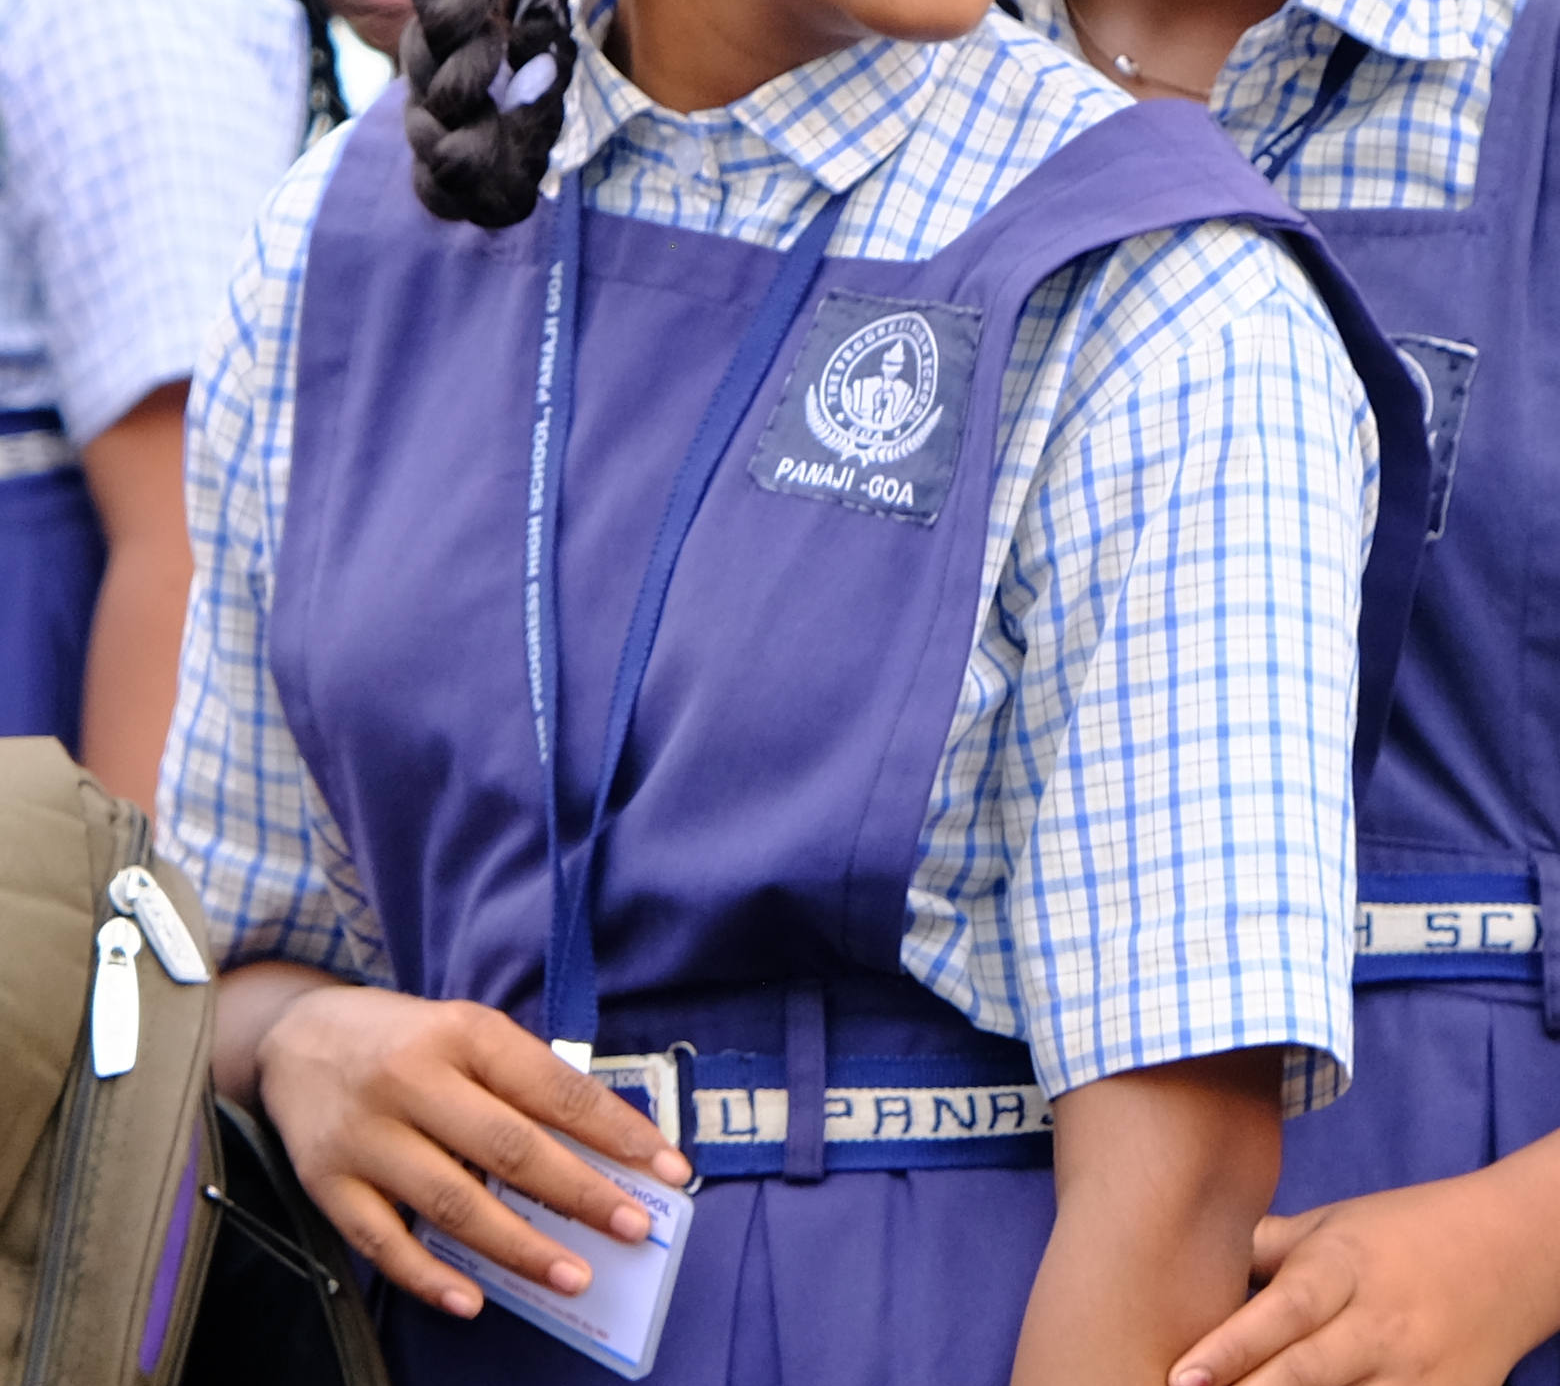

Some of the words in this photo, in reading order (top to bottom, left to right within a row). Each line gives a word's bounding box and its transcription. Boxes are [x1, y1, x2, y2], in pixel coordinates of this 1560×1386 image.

[546, 260, 564, 314] GOA
[774, 456, 856, 493] PANAJI
[825, 1090, 1054, 1138] PANA
